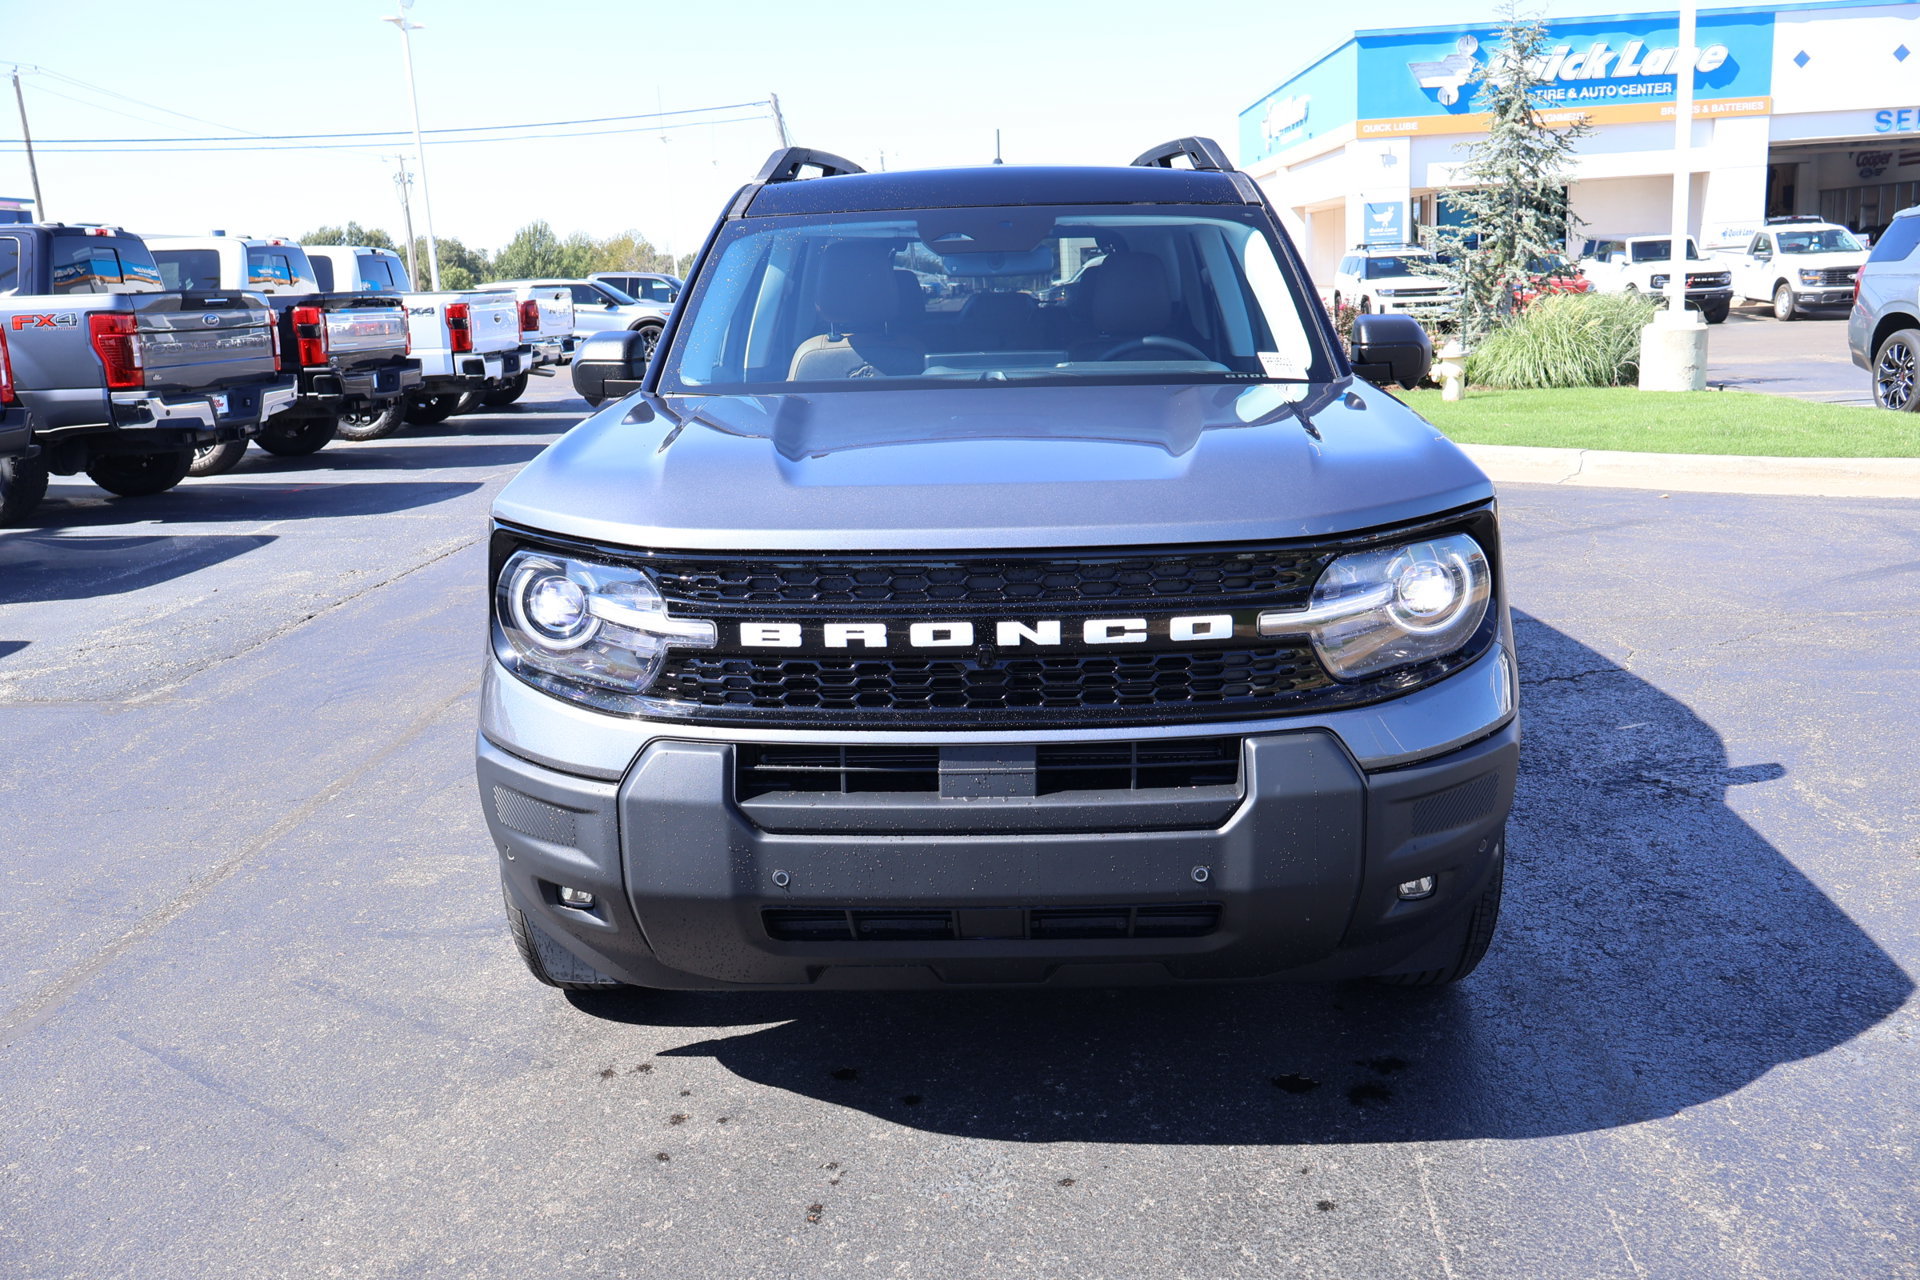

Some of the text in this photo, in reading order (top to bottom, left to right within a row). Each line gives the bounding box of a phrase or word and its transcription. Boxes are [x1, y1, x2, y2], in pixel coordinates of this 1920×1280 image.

[1535, 82, 1673, 101] TIRE & AUTO CENTER
[1711, 101, 1765, 113] BATTERIES
[1363, 121, 1419, 133] QUICK LUBE
[1874, 109, 1920, 132] SE
[410, 307, 435, 315] X4
[11, 313, 78, 331] FX4
[740, 615, 1233, 648] BRONCO
